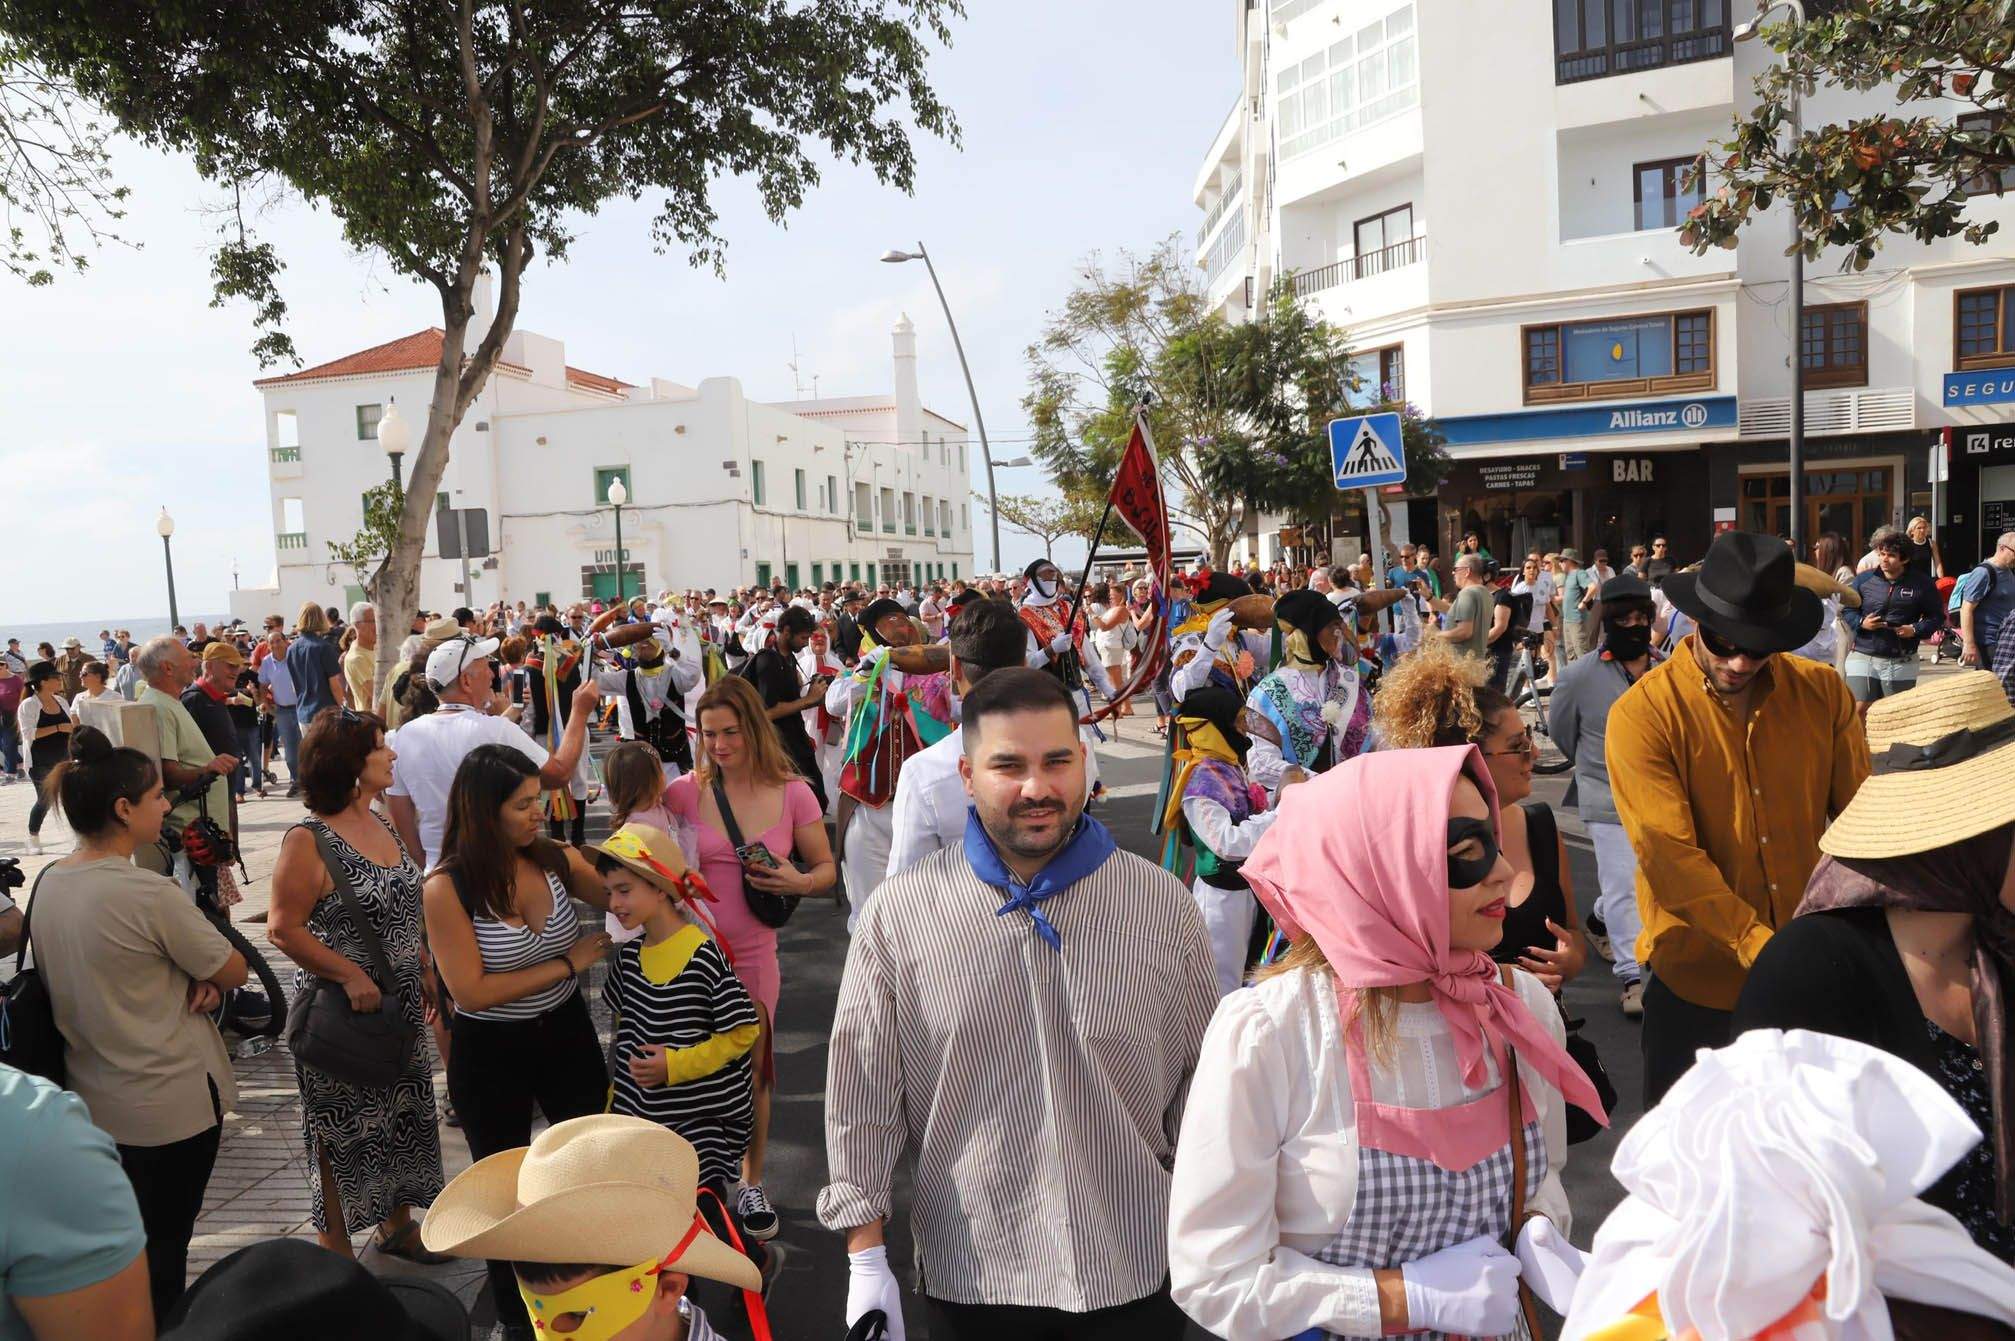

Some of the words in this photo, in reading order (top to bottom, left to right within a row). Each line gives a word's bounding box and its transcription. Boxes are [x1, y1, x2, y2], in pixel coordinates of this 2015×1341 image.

[1948, 381, 2015, 398] SEGU
[1610, 410, 1678, 428] Allianz
[1994, 437, 2015, 449] re
[1516, 464, 1541, 472] SNACKS
[1613, 459, 1654, 482] BAR
[1508, 472, 1536, 480] FRESCAS
[1486, 481, 1510, 489] CARNES
